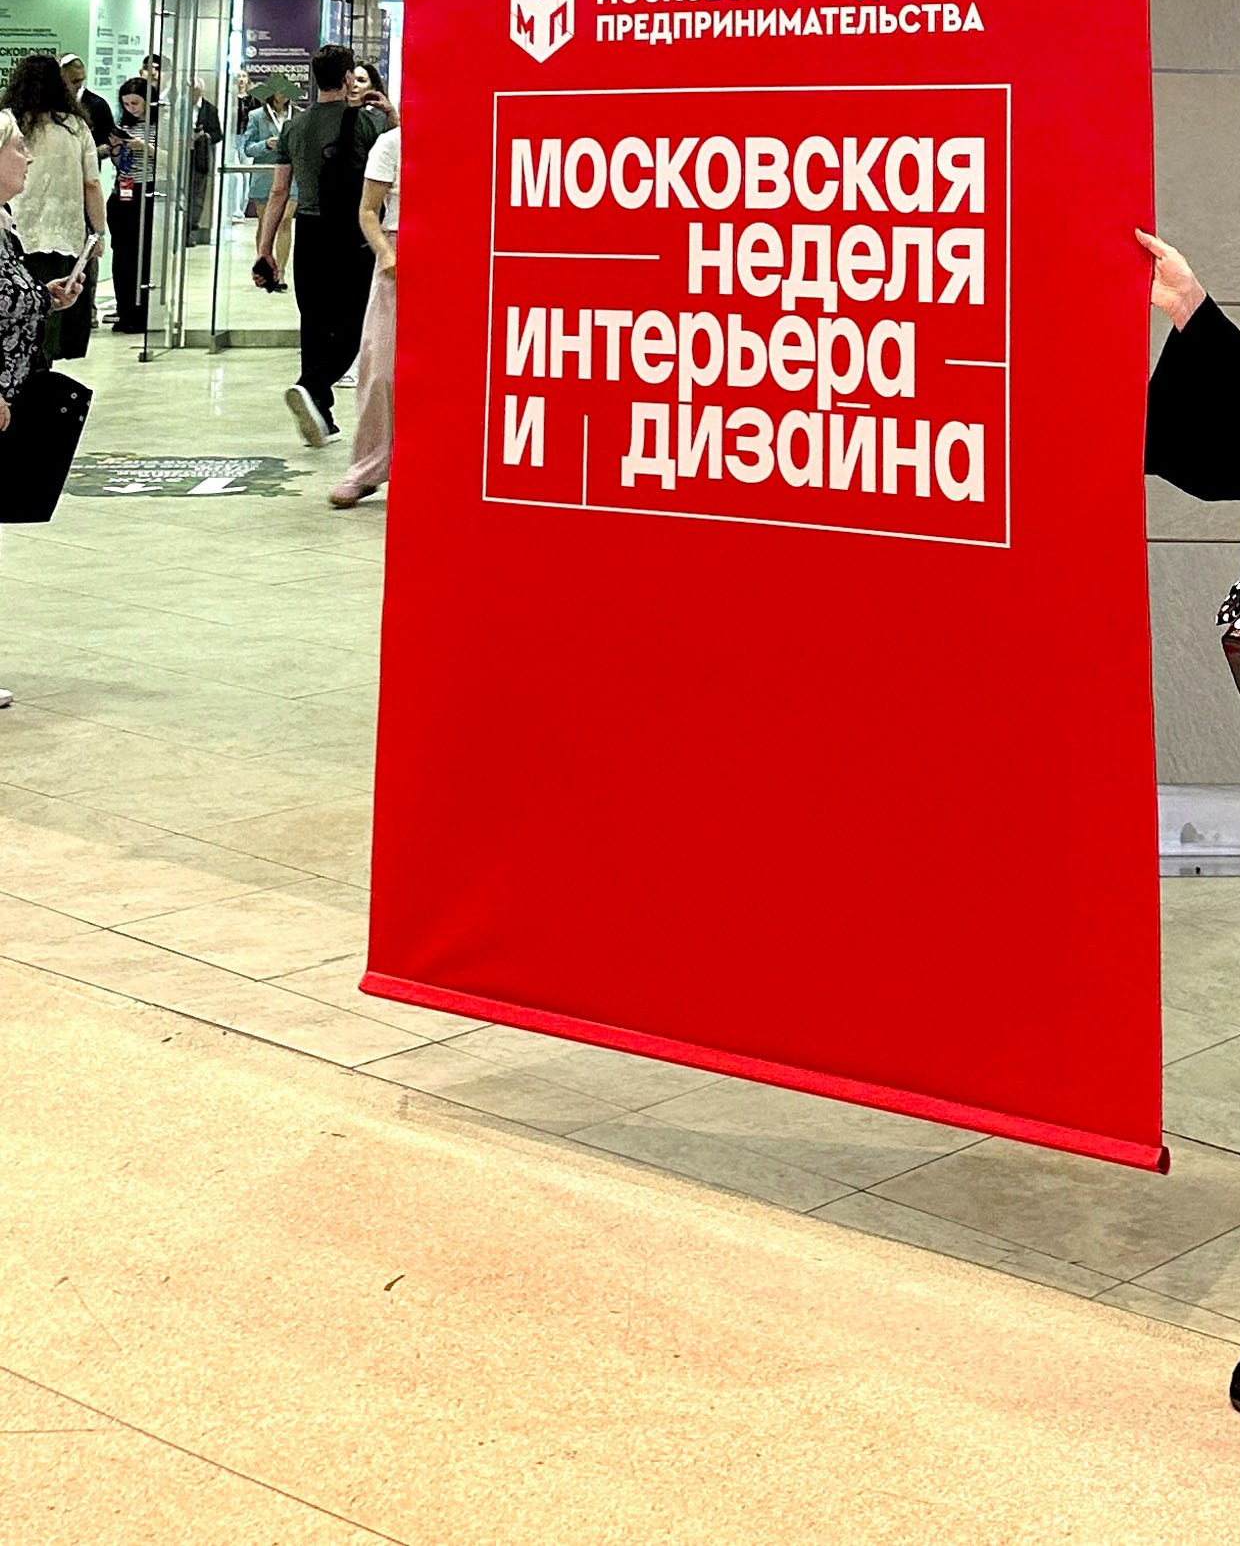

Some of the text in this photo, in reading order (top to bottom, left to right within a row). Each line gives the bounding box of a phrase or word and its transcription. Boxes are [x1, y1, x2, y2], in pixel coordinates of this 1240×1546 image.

[596, 2, 985, 46] ПРЕДПРИНИМАТЕЛЬСТВА
[688, 222, 985, 313] неделя
[505, 306, 916, 411] интерьера
[503, 394, 985, 503] и дизайна
